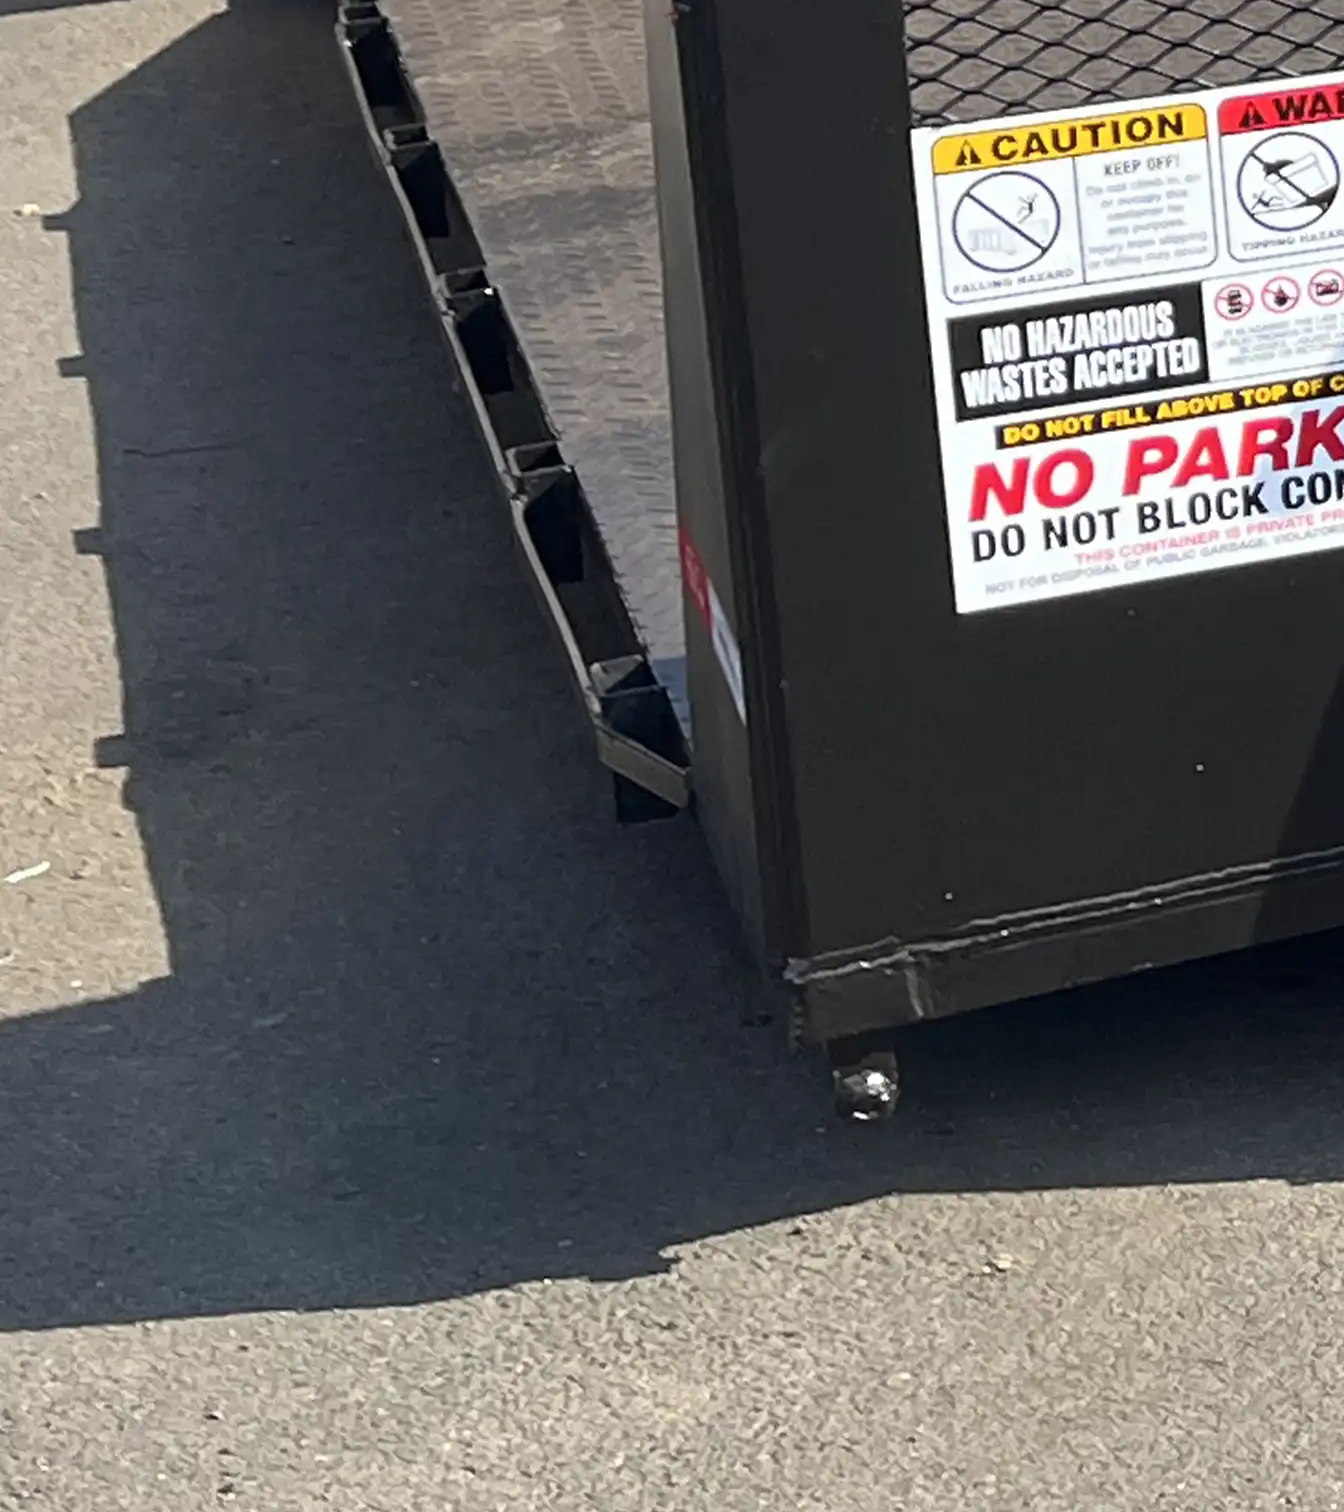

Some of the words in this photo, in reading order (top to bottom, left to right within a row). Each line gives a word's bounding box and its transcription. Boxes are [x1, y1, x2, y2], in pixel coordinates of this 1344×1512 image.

[992, 111, 1184, 162] CAUTION
[1103, 160, 1141, 177] KEEP
[981, 324, 1022, 366] NO
[1026, 300, 1175, 359] HAZARDOUS
[960, 356, 1067, 409] WASTES
[1073, 336, 1200, 391] ACCEPTED
[1003, 423, 1040, 446] DO
[1045, 413, 1096, 438] NOT
[1101, 405, 1152, 430] FILL
[1156, 391, 1236, 421] ABOVE
[1240, 384, 1288, 407] TOP
[1292, 377, 1325, 397] OF
[968, 448, 1095, 523] NO
[972, 523, 1026, 563] DO
[1042, 506, 1121, 551] NOT
[1137, 479, 1269, 535] BLOCK
[1074, 547, 1115, 565] THIS
[1119, 528, 1220, 558] CONTAINER
[1226, 525, 1242, 540] IS
[1246, 513, 1315, 537] PRIVATE
